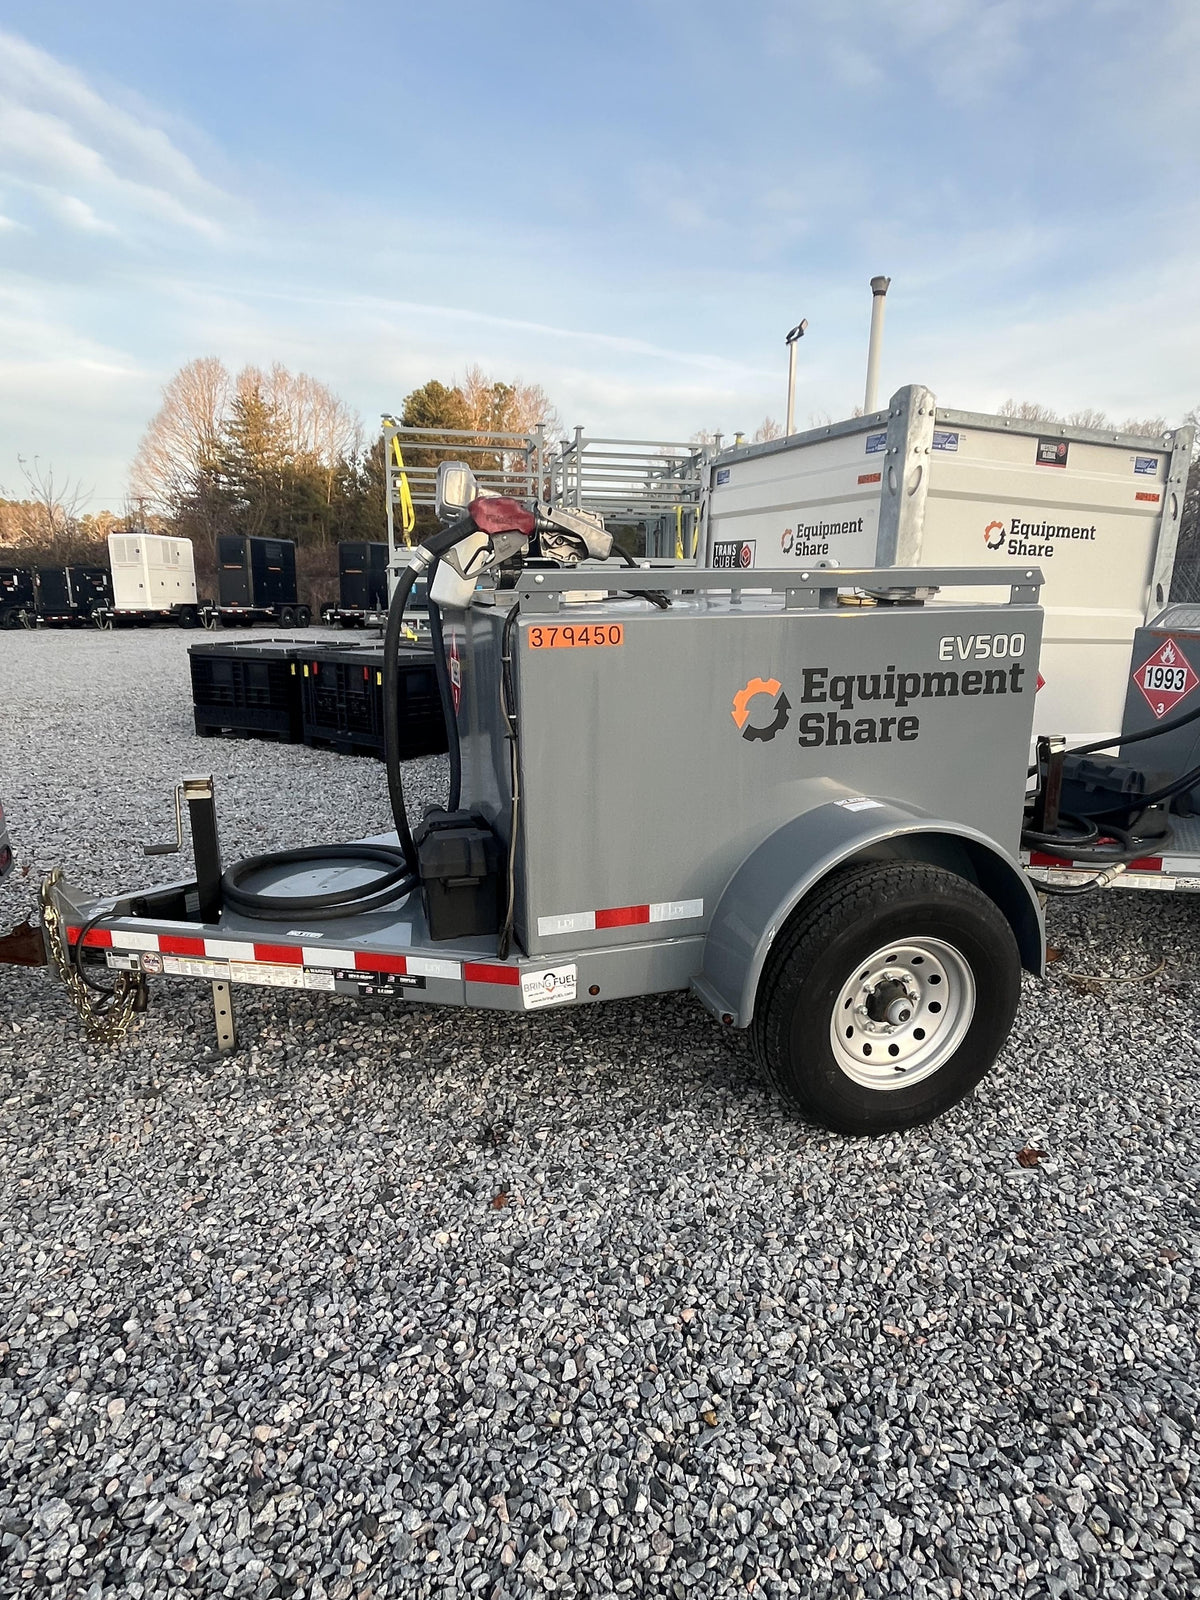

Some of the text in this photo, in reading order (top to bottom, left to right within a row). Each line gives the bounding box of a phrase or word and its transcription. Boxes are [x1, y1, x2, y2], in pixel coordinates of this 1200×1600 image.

[796, 517, 864, 540] Equipment
[1009, 518, 1097, 541] Equipment
[714, 543, 737, 556] TRANS
[795, 541, 829, 557] Share
[1007, 539, 1054, 557] Share
[713, 555, 736, 568] CUBE
[531, 625, 621, 648] 379450
[938, 632, 1026, 661] EV500
[801, 662, 1025, 710] Equipment
[1147, 666, 1185, 691] 1993
[1156, 702, 1165, 714] 3
[798, 711, 920, 748] Share
[523, 974, 577, 993] BRING FUEL
